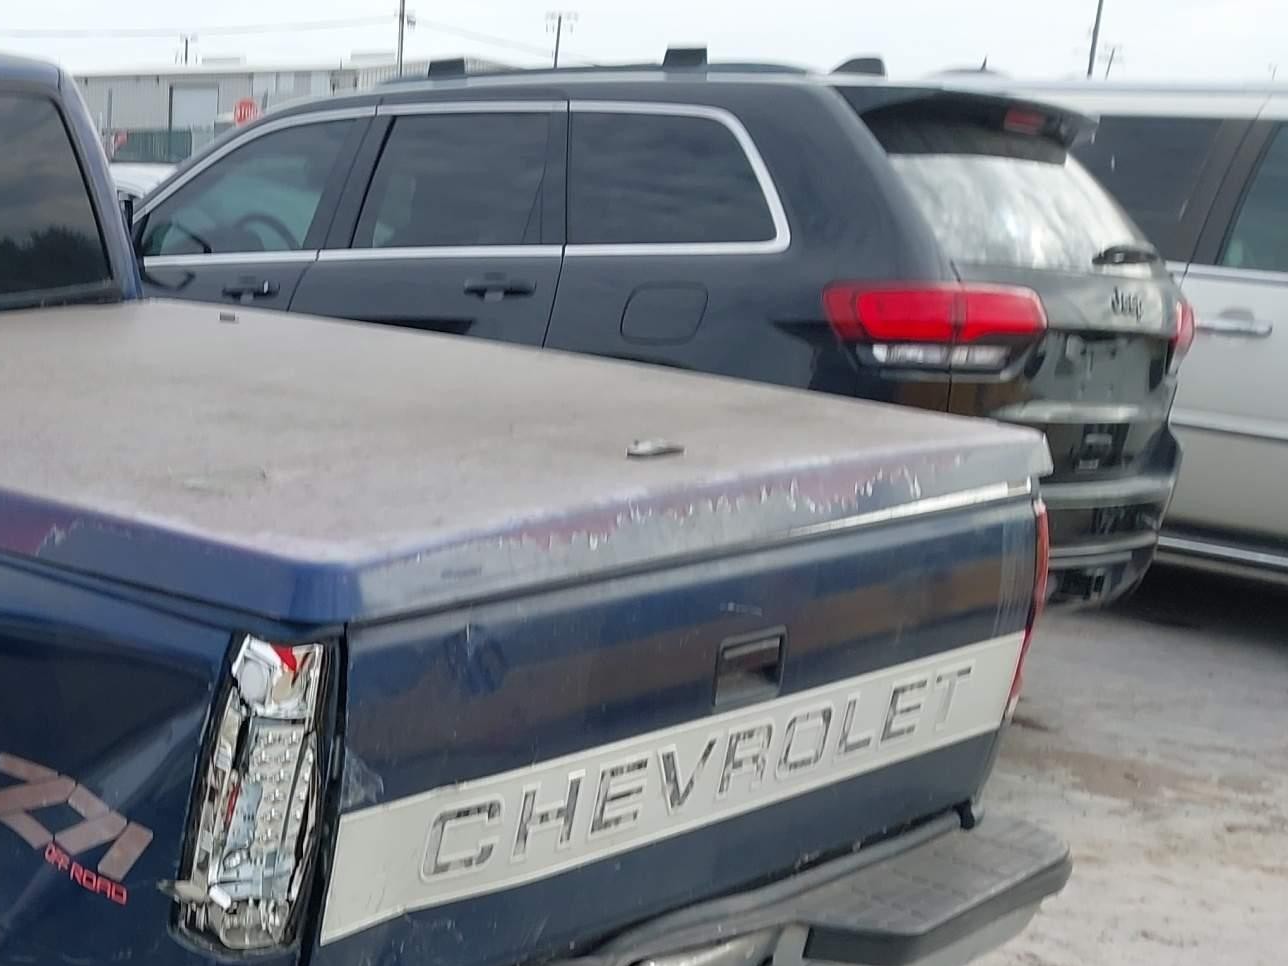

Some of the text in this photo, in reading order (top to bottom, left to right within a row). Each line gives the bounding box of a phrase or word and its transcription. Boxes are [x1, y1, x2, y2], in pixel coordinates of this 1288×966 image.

[420, 660, 975, 882] CHEVROLET
[44, 841, 128, 906] OFF ROAD
